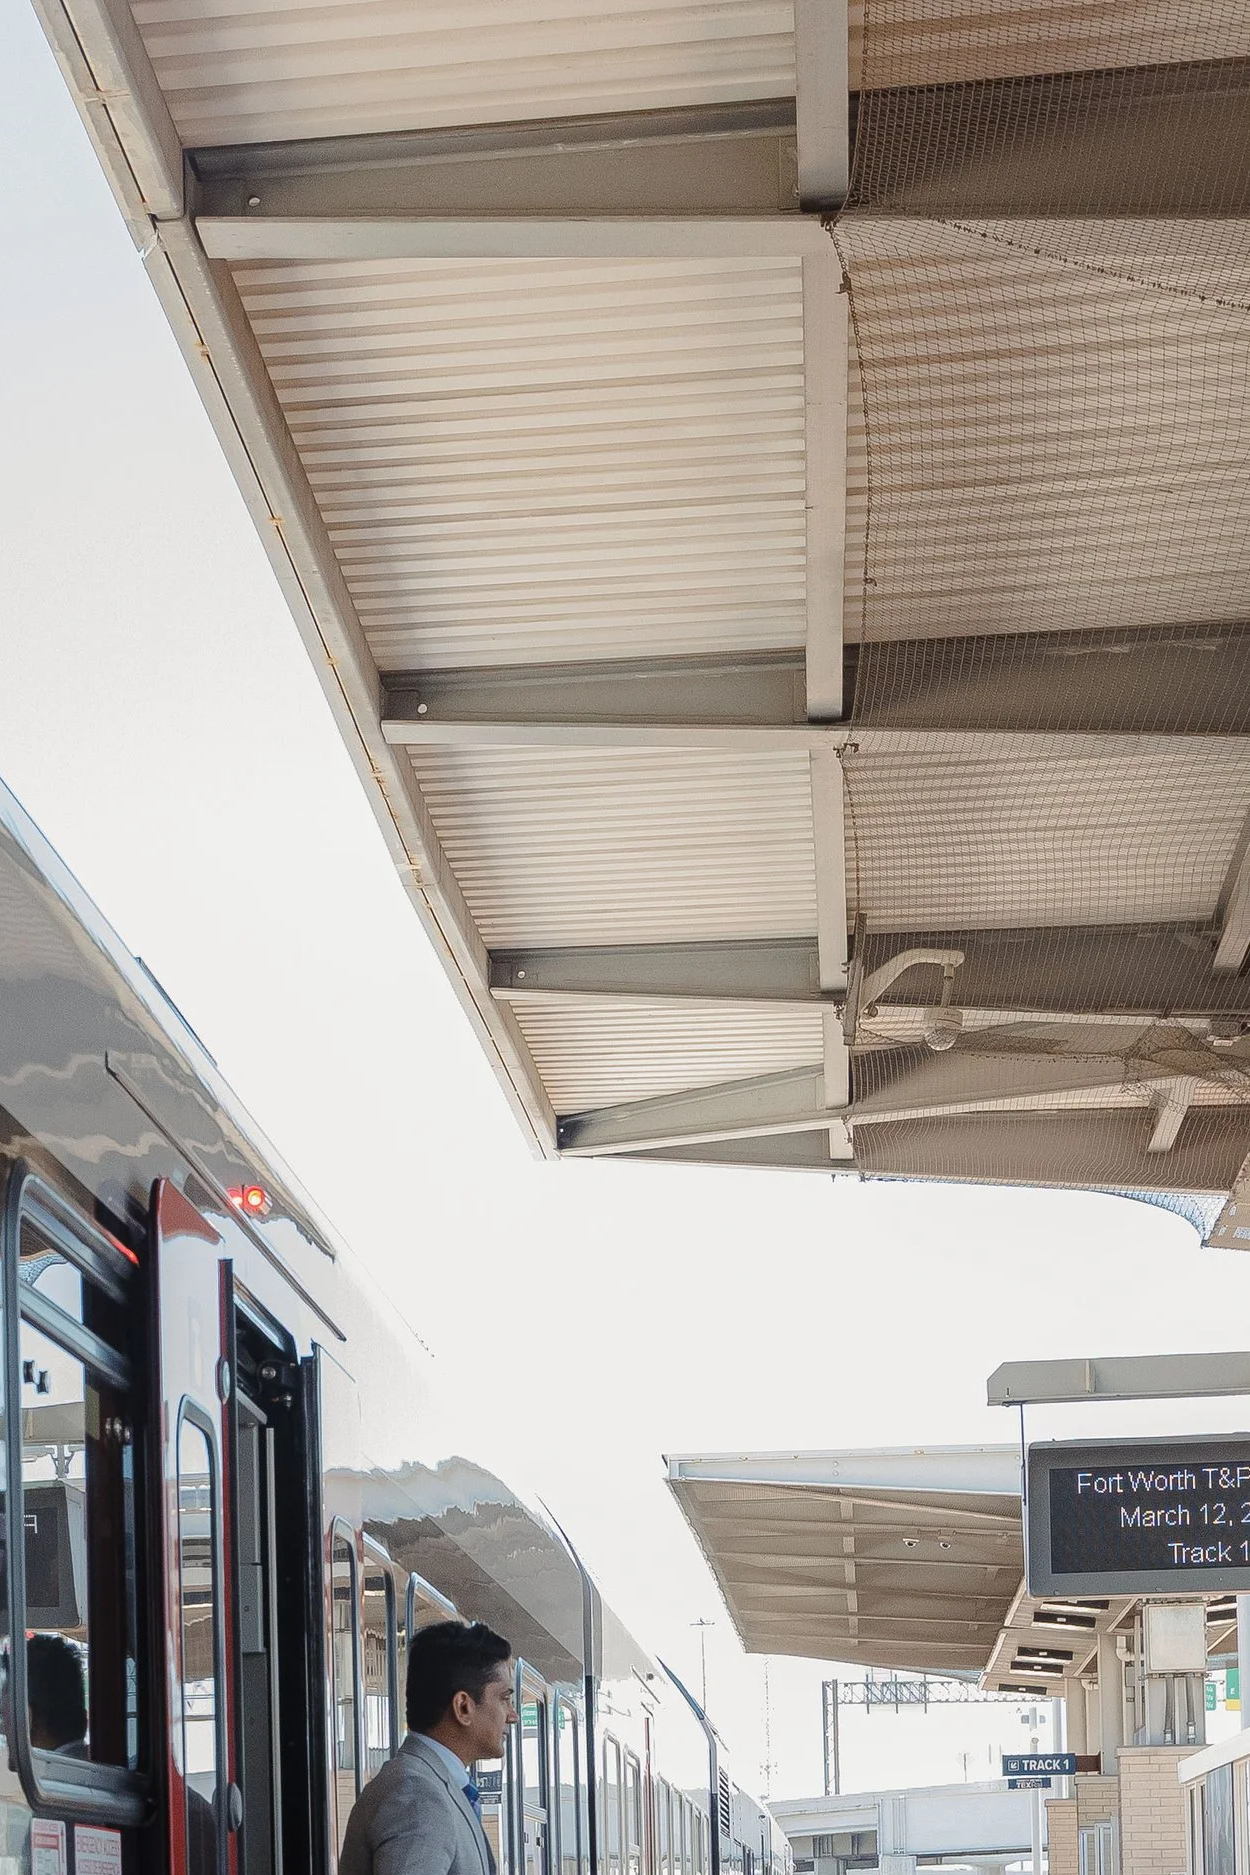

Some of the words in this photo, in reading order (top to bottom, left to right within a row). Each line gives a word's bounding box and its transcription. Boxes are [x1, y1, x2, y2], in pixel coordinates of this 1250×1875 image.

[1077, 1473, 1124, 1495] Fort
[1128, 1469, 1196, 1492] Worth
[1120, 1504, 1190, 1528] March
[1200, 1503, 1234, 1527] 12,
[1168, 1541, 1232, 1564] Track
[1021, 1759, 1061, 1771] TRACK
[1063, 1758, 1069, 1770] 1
